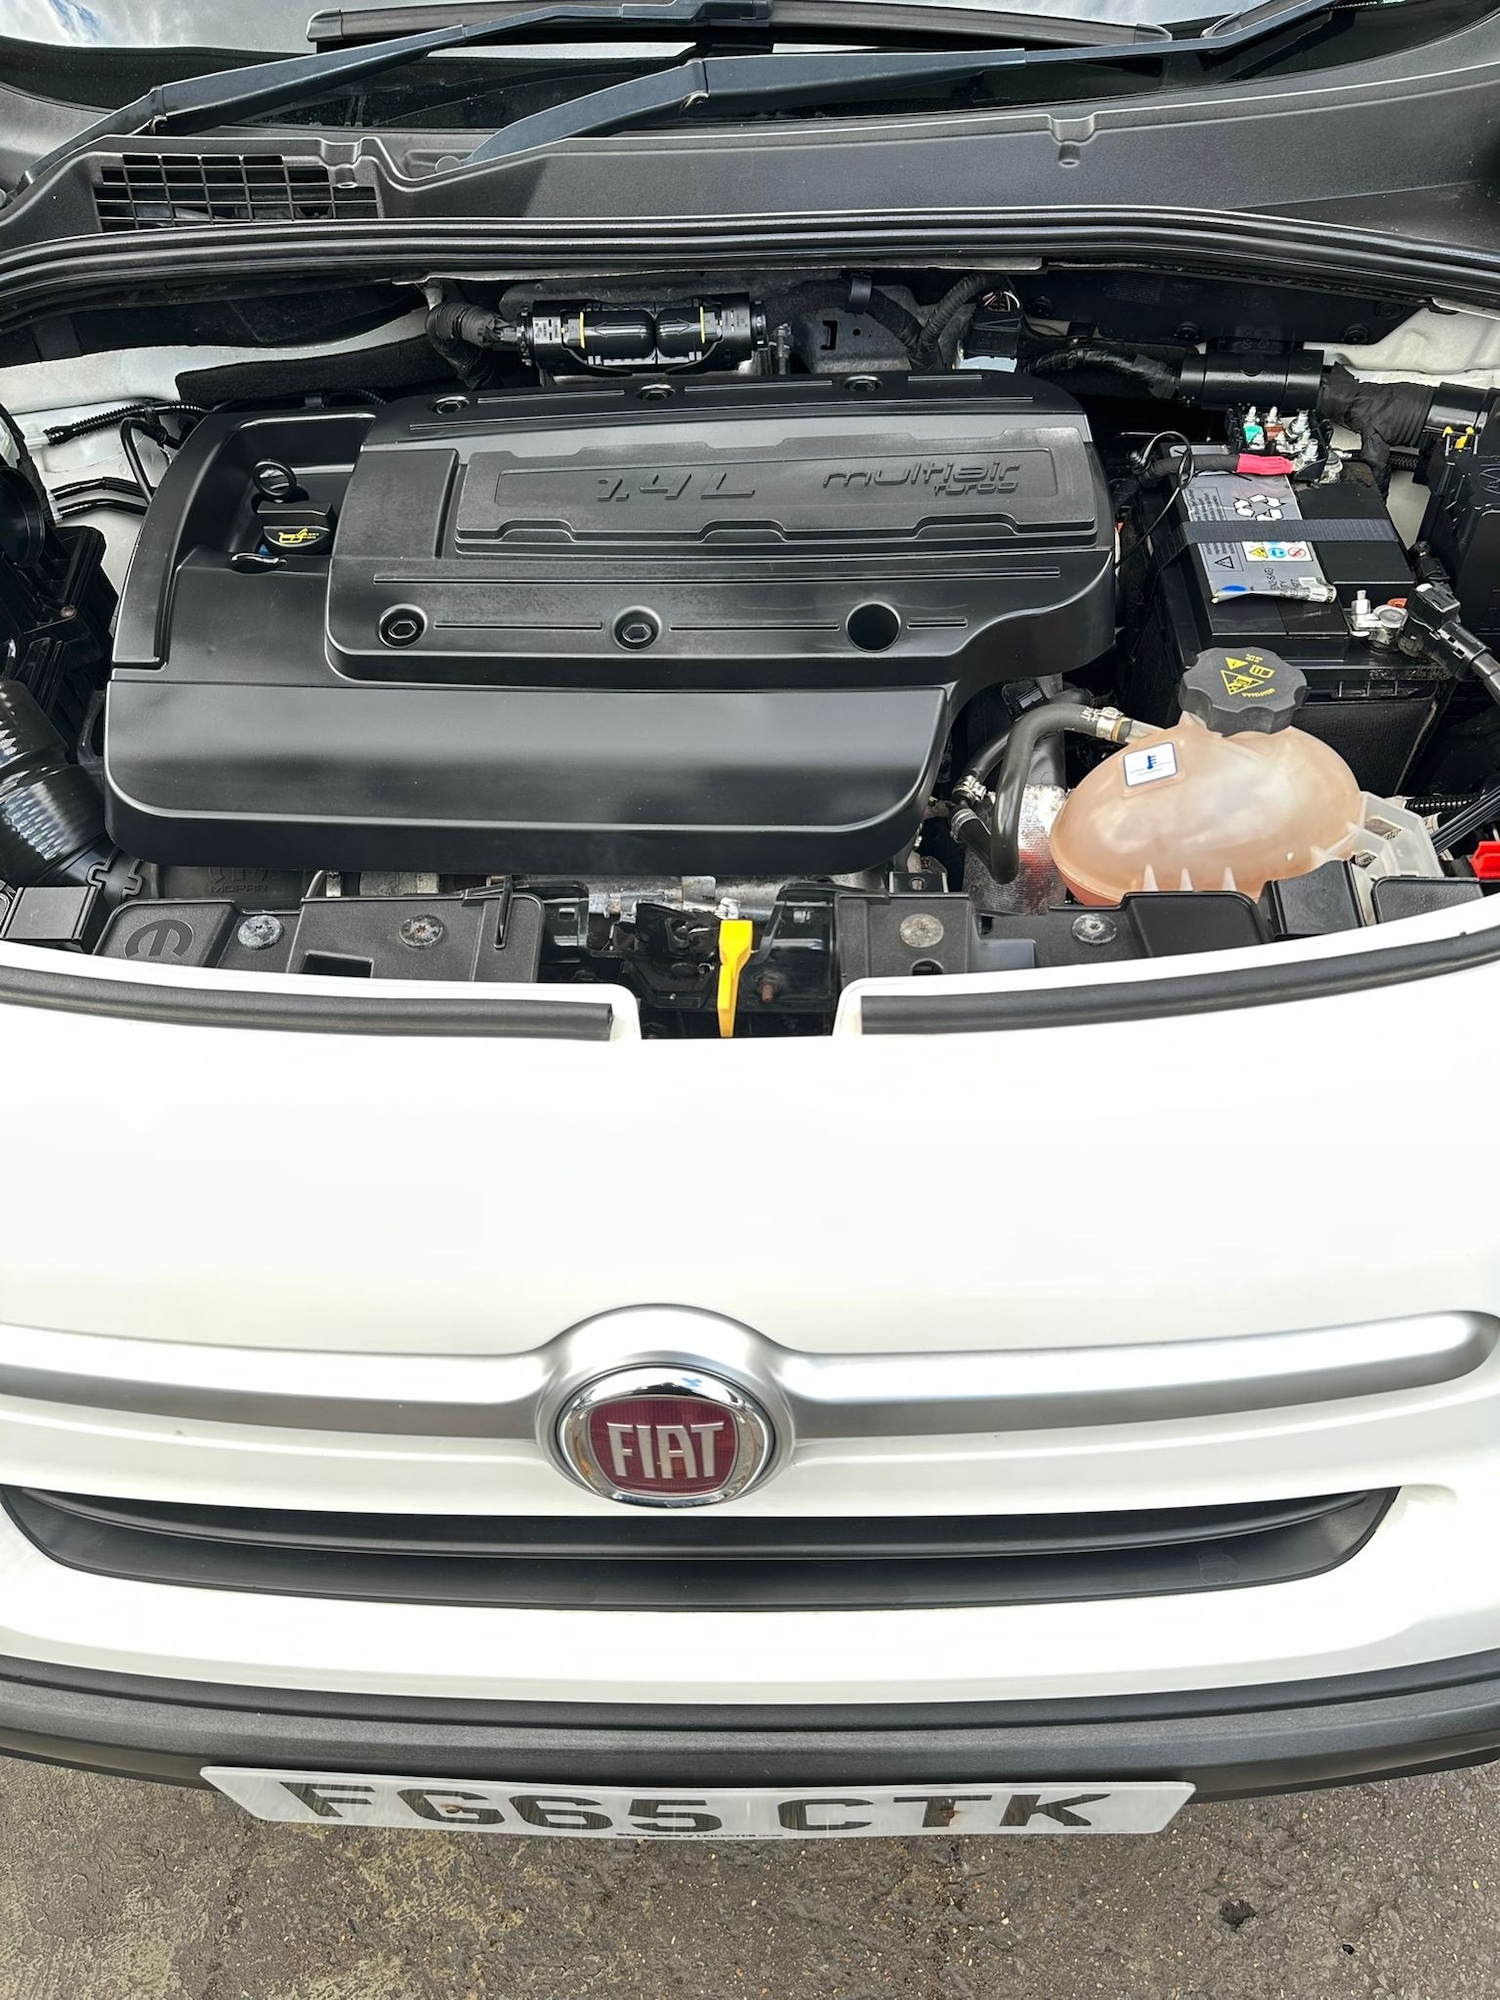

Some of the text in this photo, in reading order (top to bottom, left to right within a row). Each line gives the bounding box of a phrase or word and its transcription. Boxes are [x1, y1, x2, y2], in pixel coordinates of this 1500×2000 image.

[822, 461, 1021, 489] multiair
[211, 884, 268, 893] MOPAR
[606, 1421, 725, 1480] FIAT
[278, 1781, 1112, 1833] FG65 CTK
